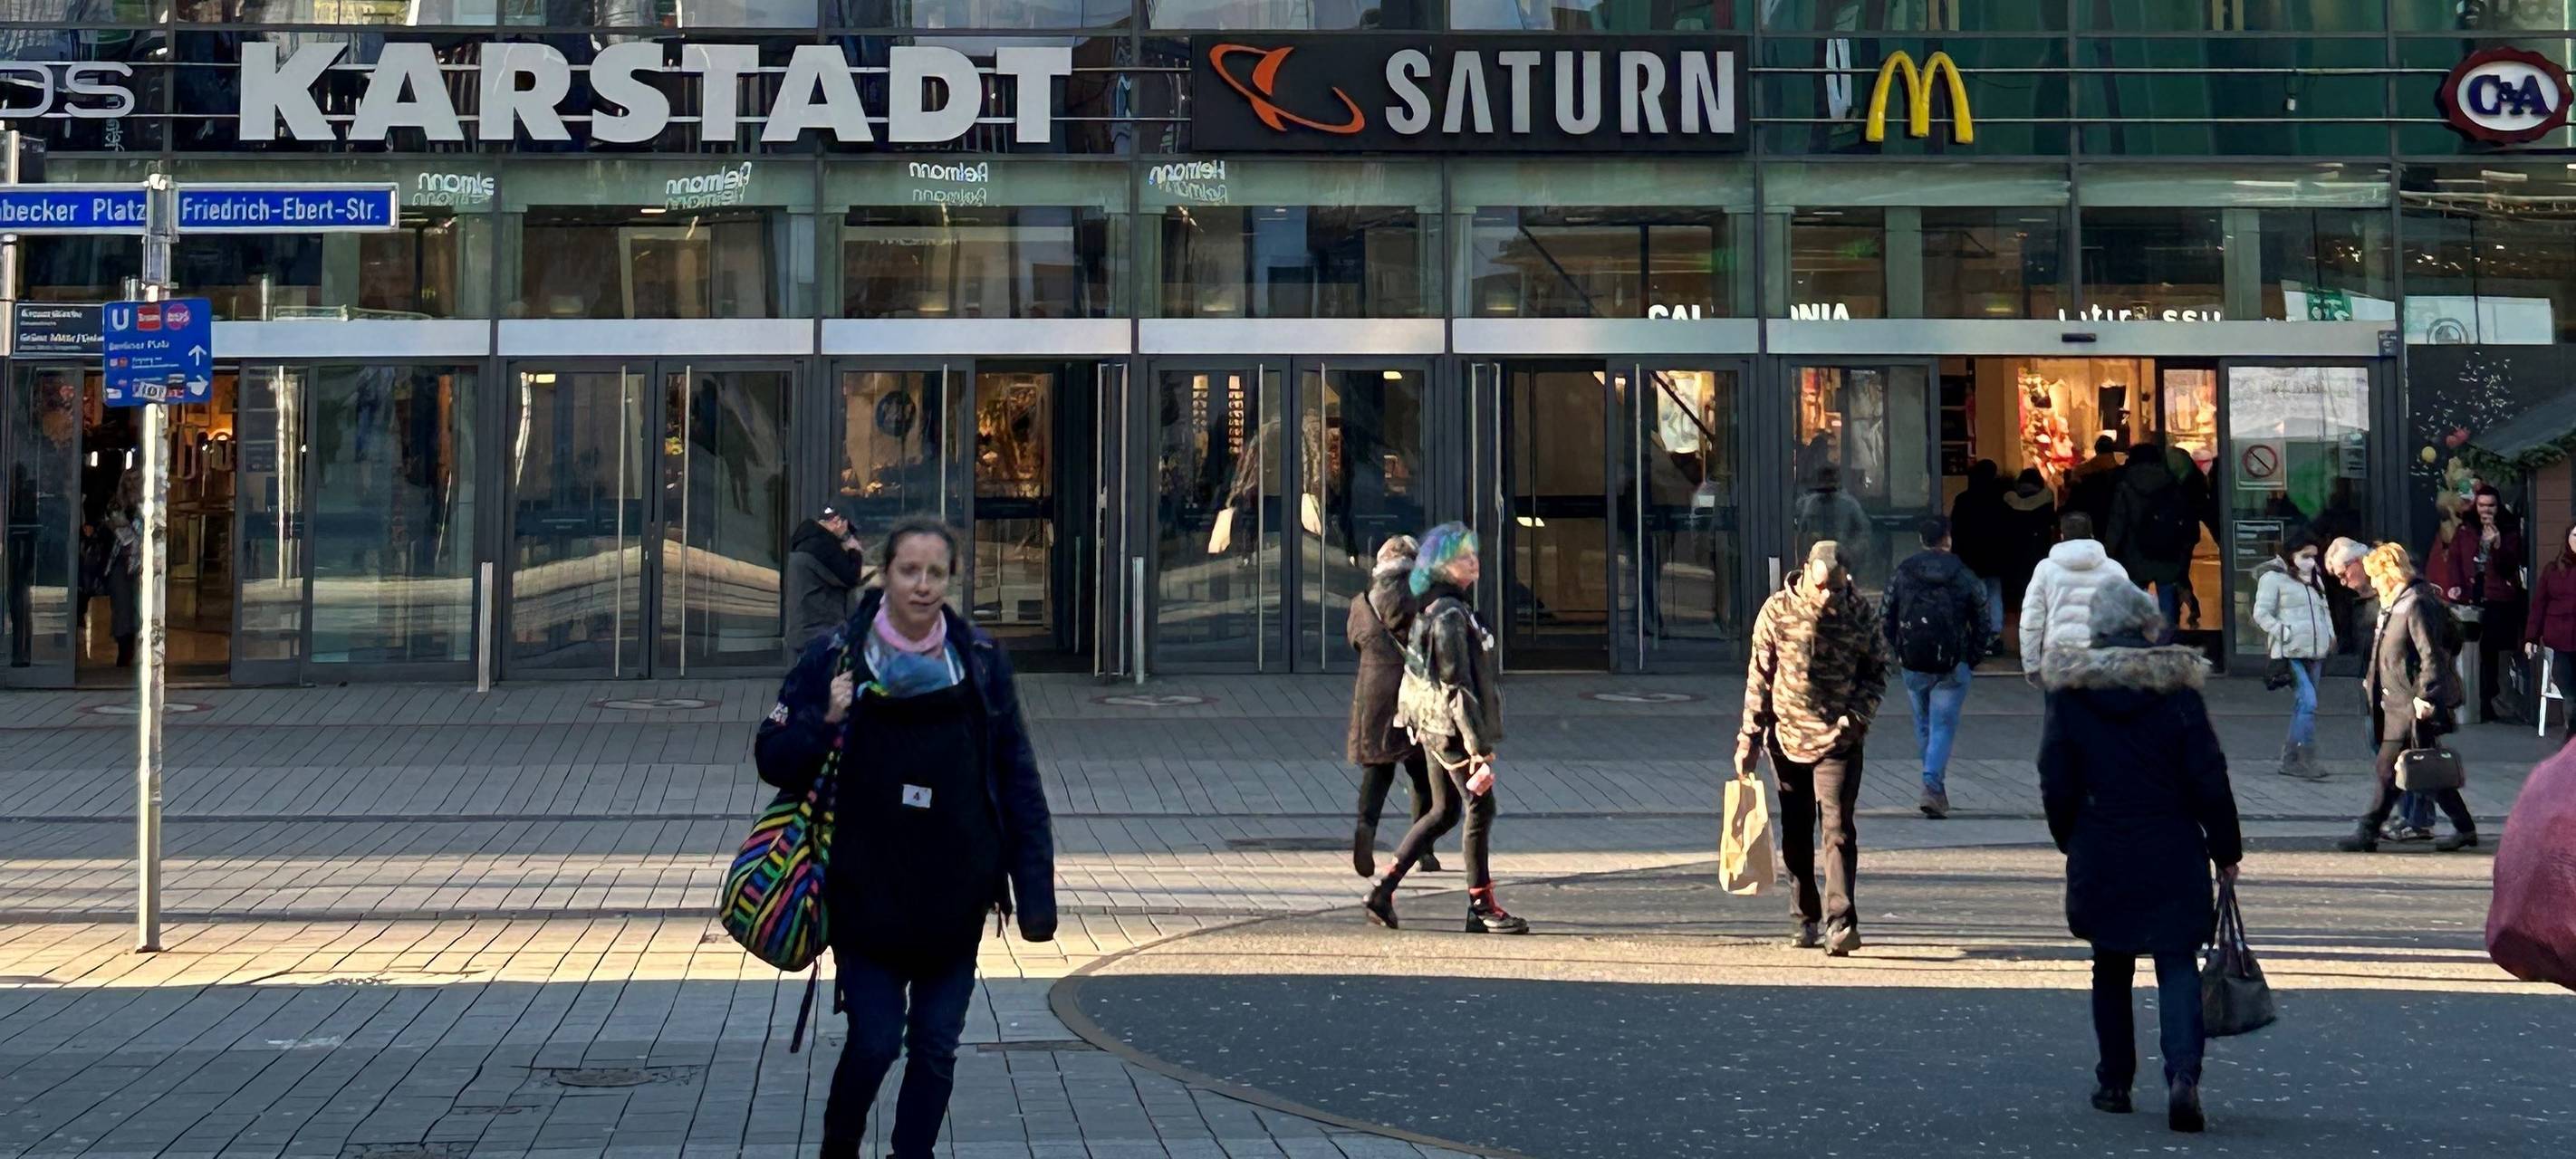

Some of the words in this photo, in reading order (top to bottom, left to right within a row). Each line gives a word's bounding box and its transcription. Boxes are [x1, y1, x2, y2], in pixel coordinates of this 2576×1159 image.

[239, 42, 1072, 143] KARSTADT
[1385, 49, 1735, 135] SATURN
[2468, 74, 2555, 116] C&A
[0, 198, 79, 222] becker
[92, 197, 146, 221] Platz
[182, 196, 380, 221] Friedrich-Ebert-Str.
[112, 309, 130, 330] U
